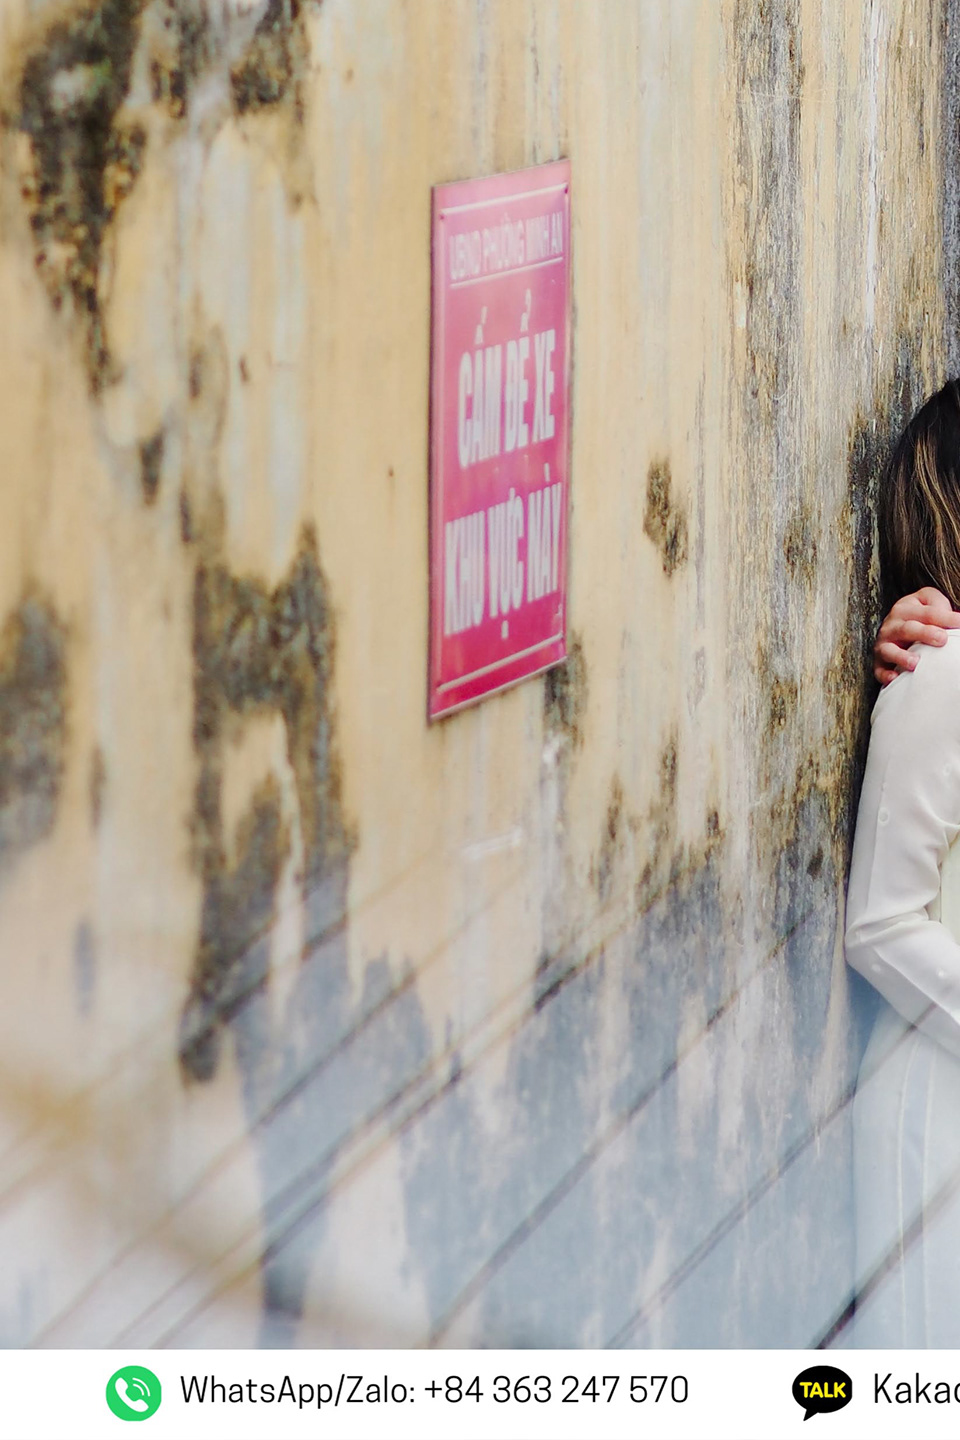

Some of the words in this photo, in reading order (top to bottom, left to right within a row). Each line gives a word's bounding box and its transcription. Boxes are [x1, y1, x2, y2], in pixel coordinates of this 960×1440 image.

[448, 230, 481, 281] UBND
[550, 210, 564, 255] AN
[457, 306, 502, 471] CẤM
[503, 289, 530, 453] ĐỂ
[532, 328, 557, 444] XE
[443, 510, 486, 637] KHU
[486, 486, 525, 640] VỰC
[526, 461, 562, 602] NÀY
